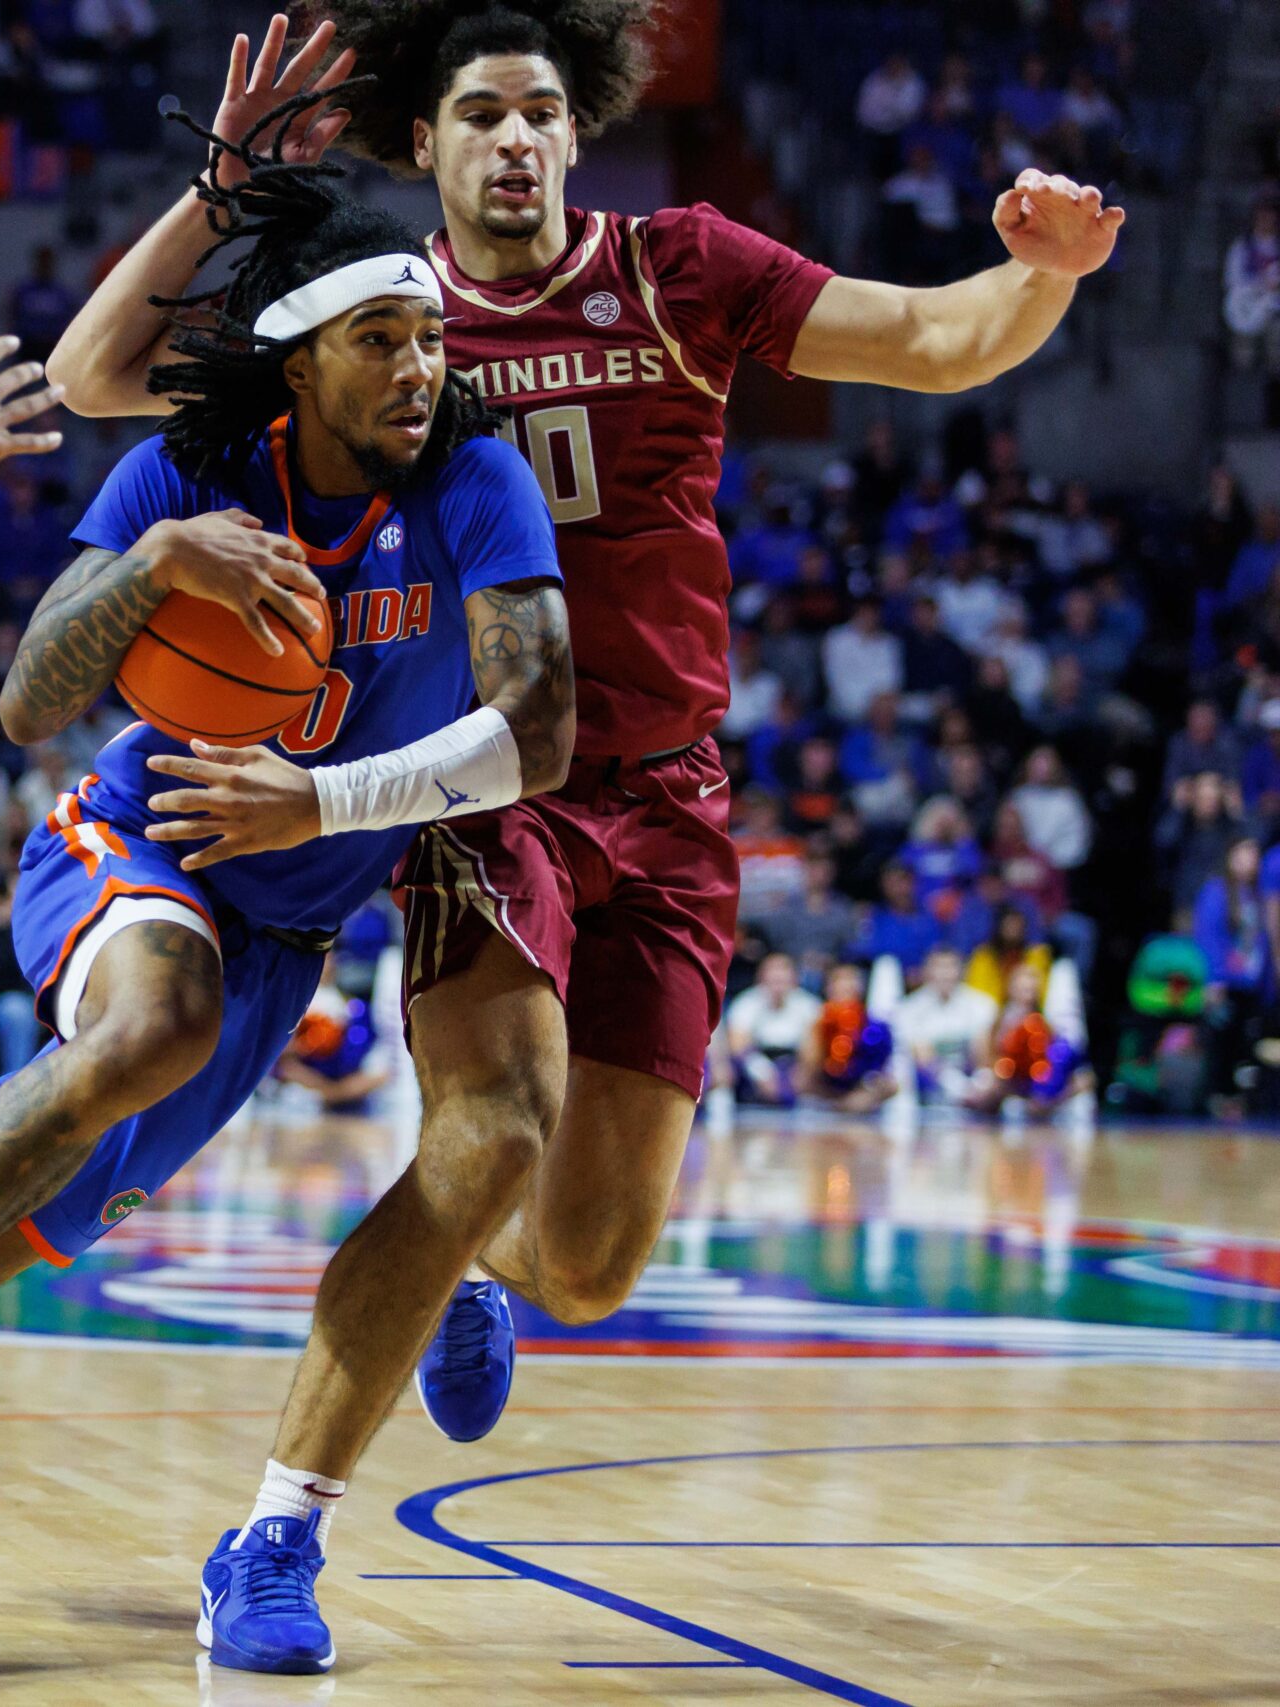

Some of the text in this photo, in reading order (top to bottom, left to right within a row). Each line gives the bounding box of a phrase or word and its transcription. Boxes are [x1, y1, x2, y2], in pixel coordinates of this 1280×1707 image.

[590, 301, 616, 312] ACC
[379, 526, 401, 550] SEC
[277, 667, 354, 754] 0
